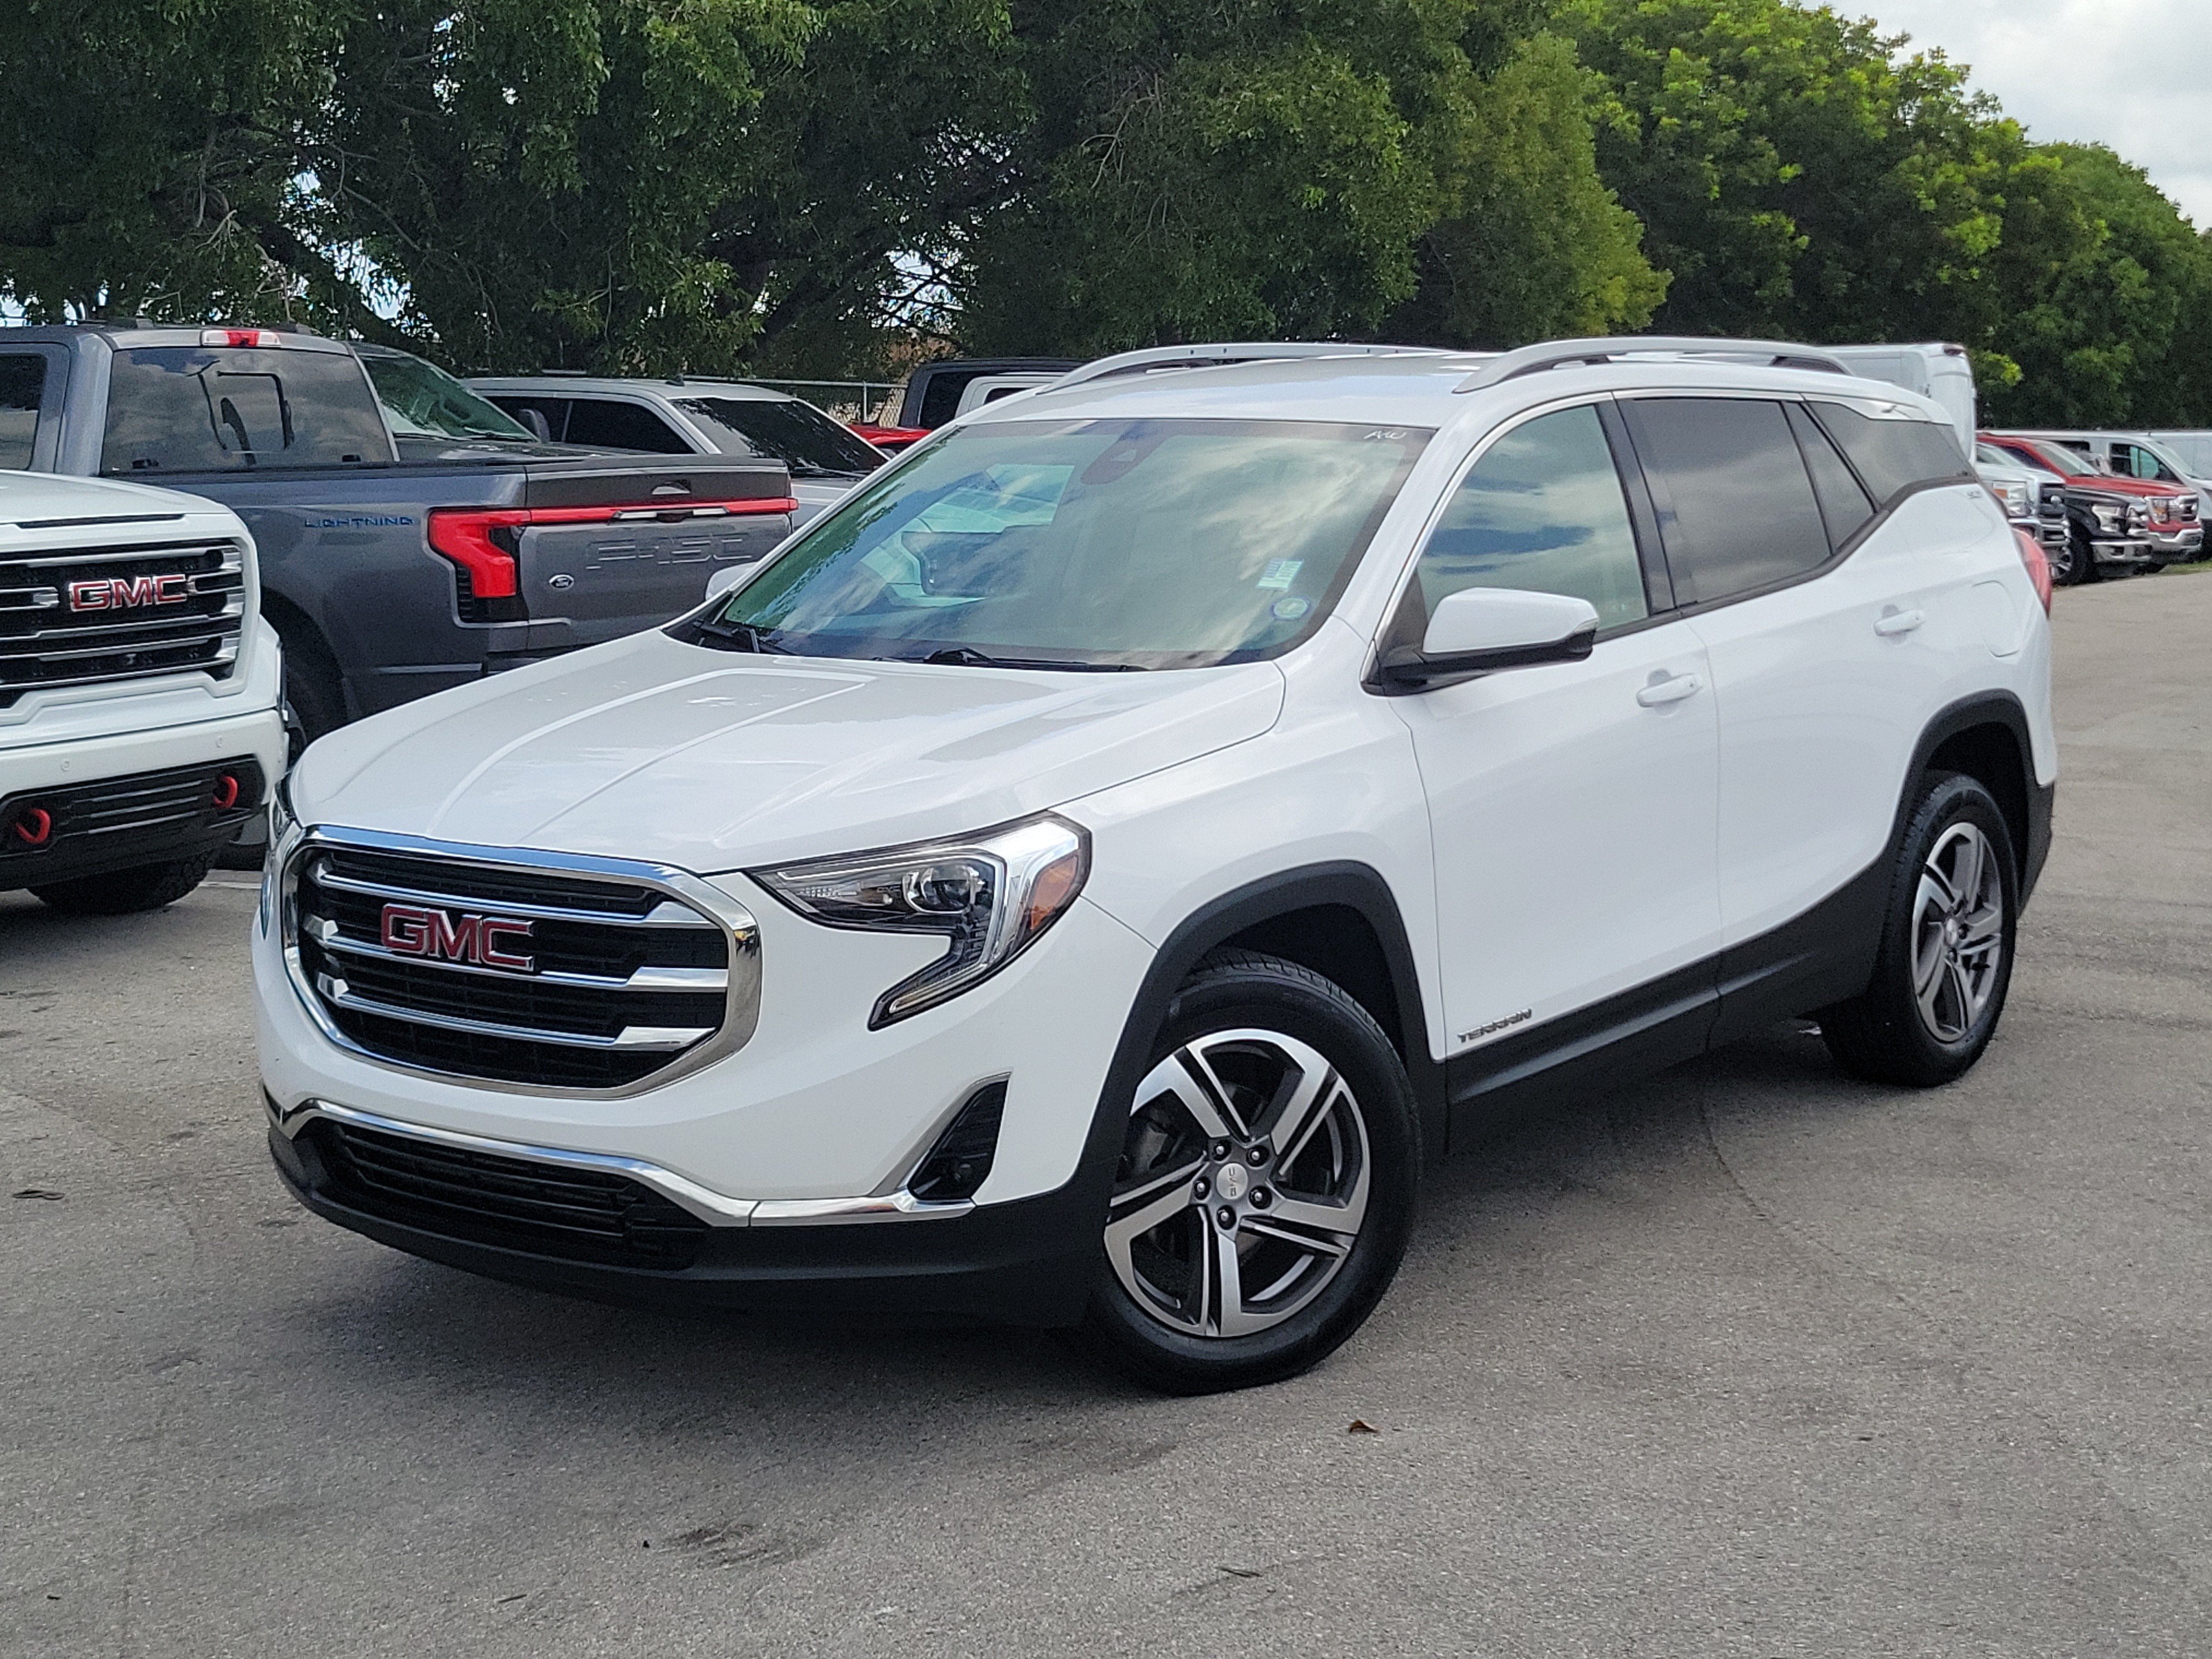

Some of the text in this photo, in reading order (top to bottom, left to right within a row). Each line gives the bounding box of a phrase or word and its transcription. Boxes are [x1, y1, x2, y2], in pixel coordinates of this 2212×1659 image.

[304, 516, 414, 528] LIGHTNING
[69, 574, 188, 612] GMC
[381, 902, 535, 972] GMC
[1457, 1008, 1532, 1043] TERRAIN
